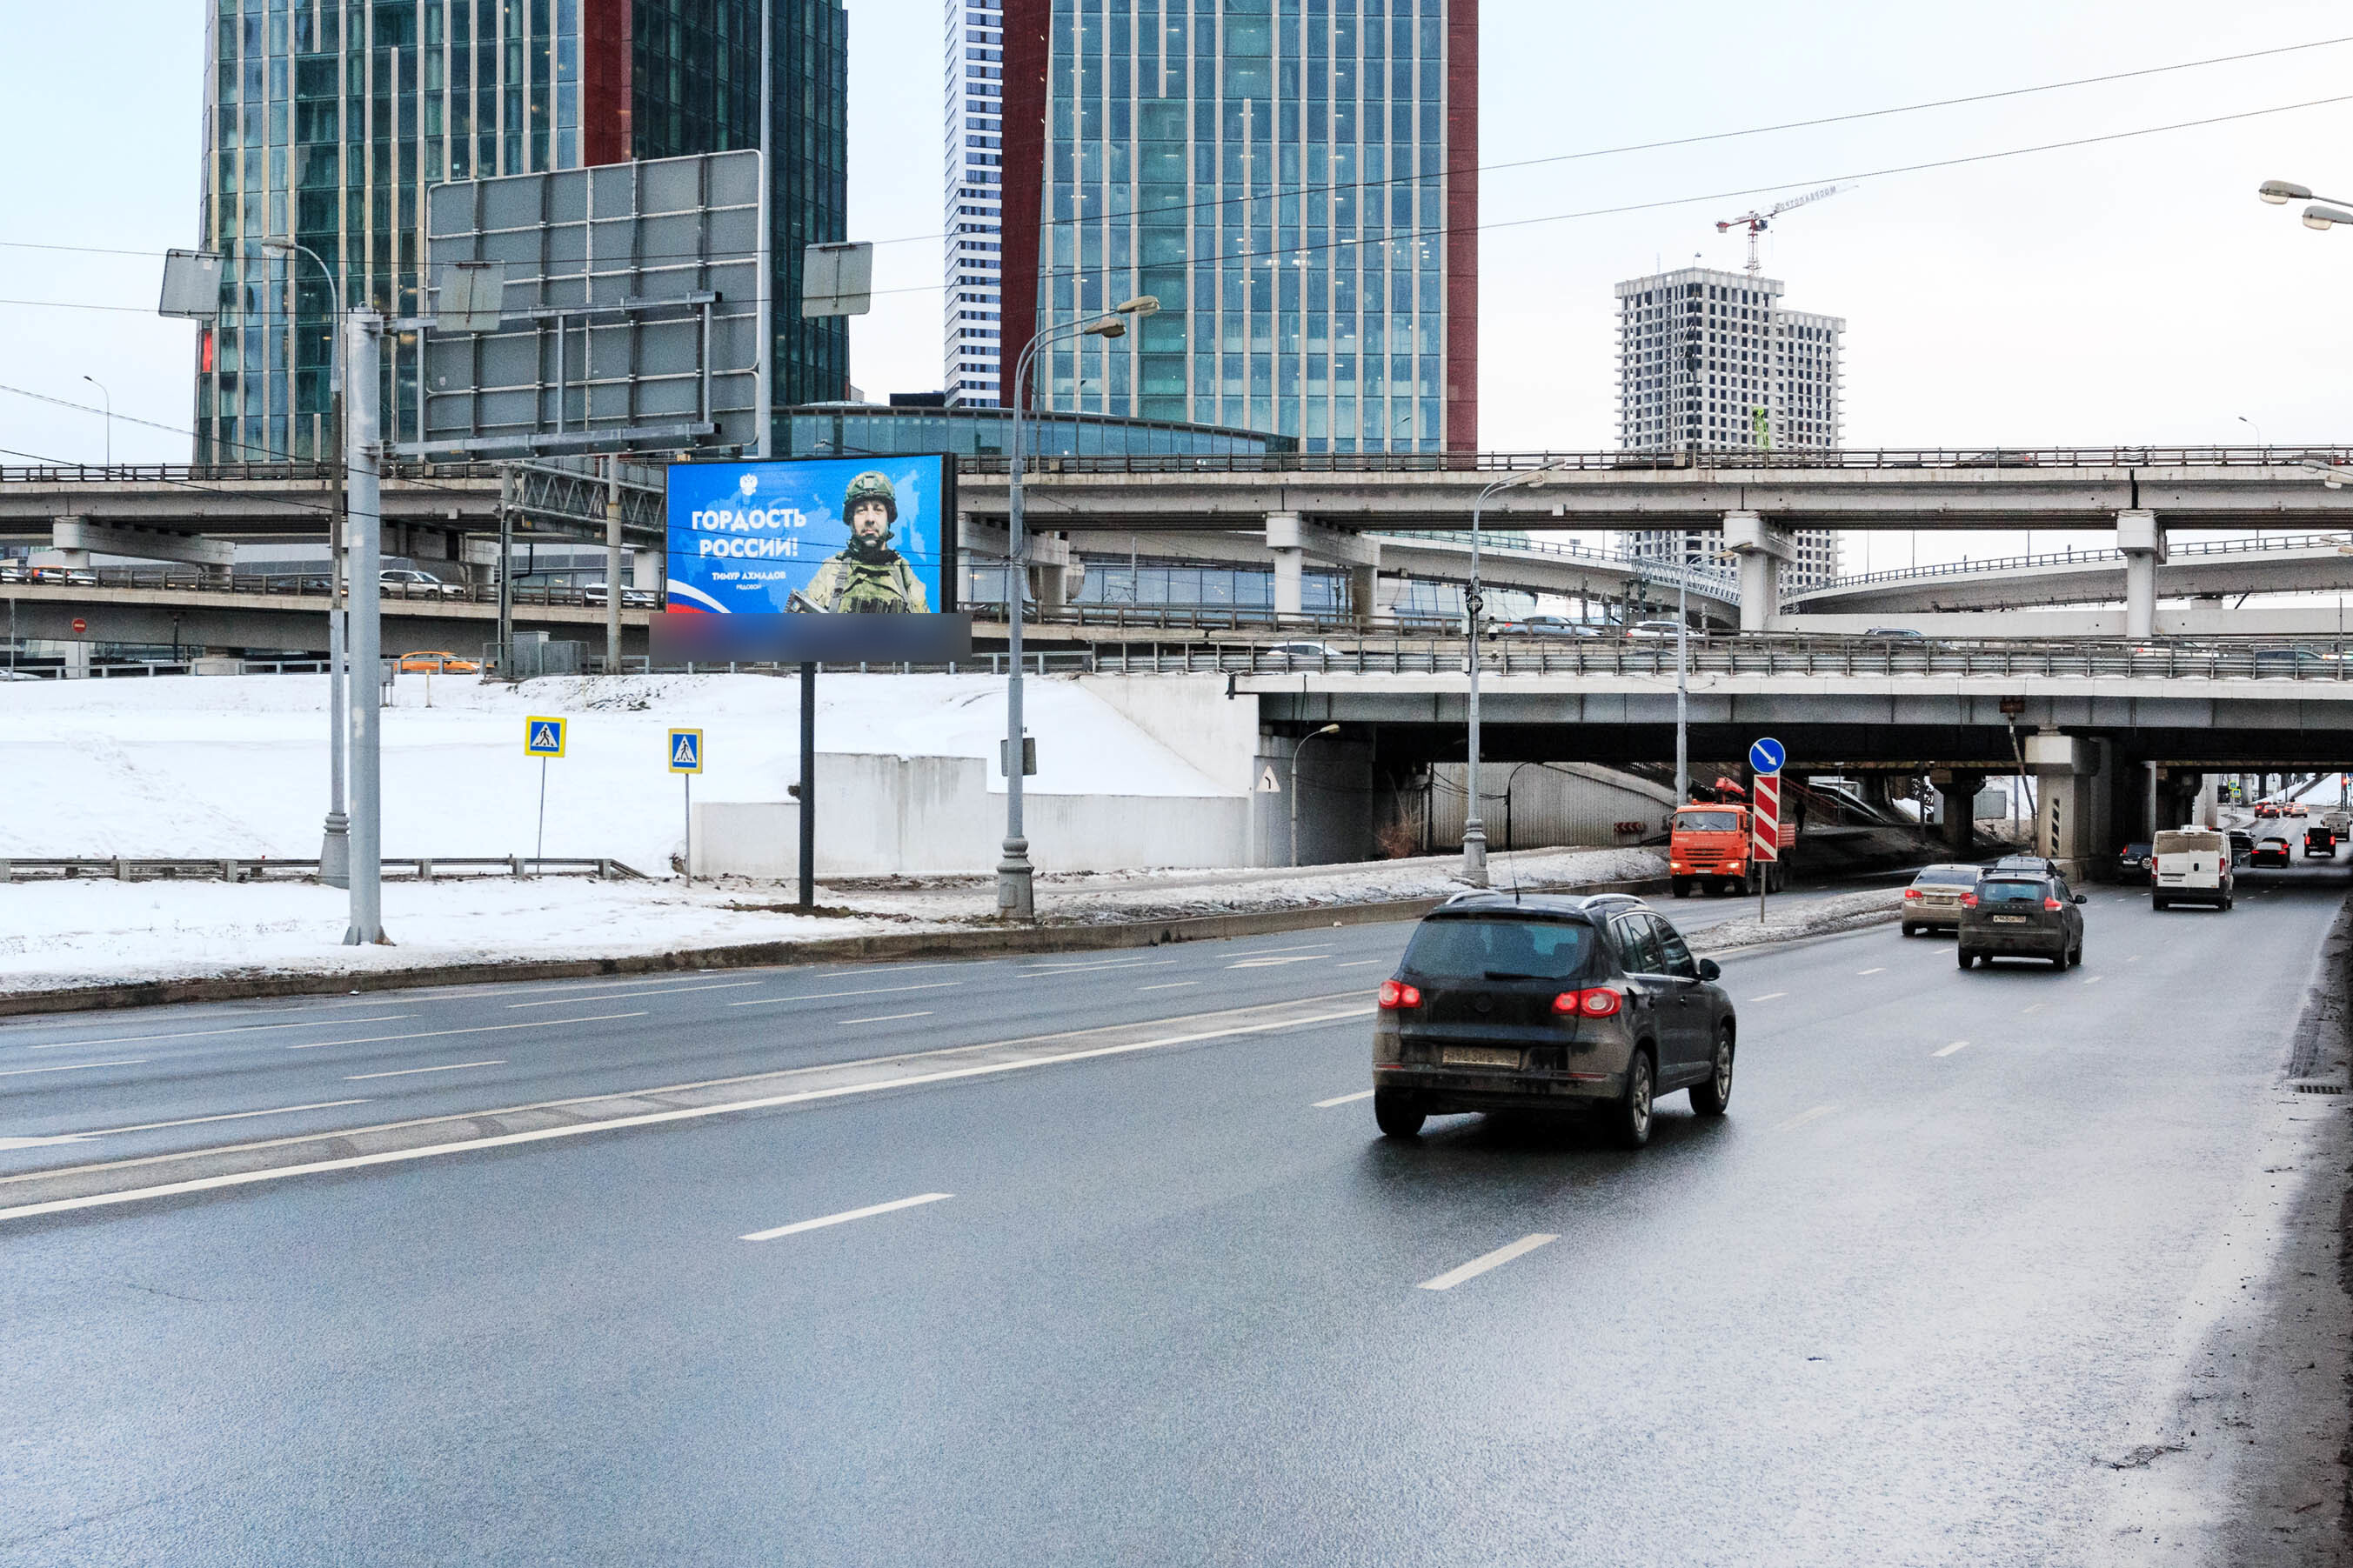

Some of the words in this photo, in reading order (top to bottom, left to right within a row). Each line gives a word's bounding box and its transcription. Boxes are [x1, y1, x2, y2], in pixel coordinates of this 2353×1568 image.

[692, 508, 807, 531] ГОРДОСТЬ
[699, 537, 799, 558] РОССИИ!
[741, 570, 786, 580] АХМАДОВ
